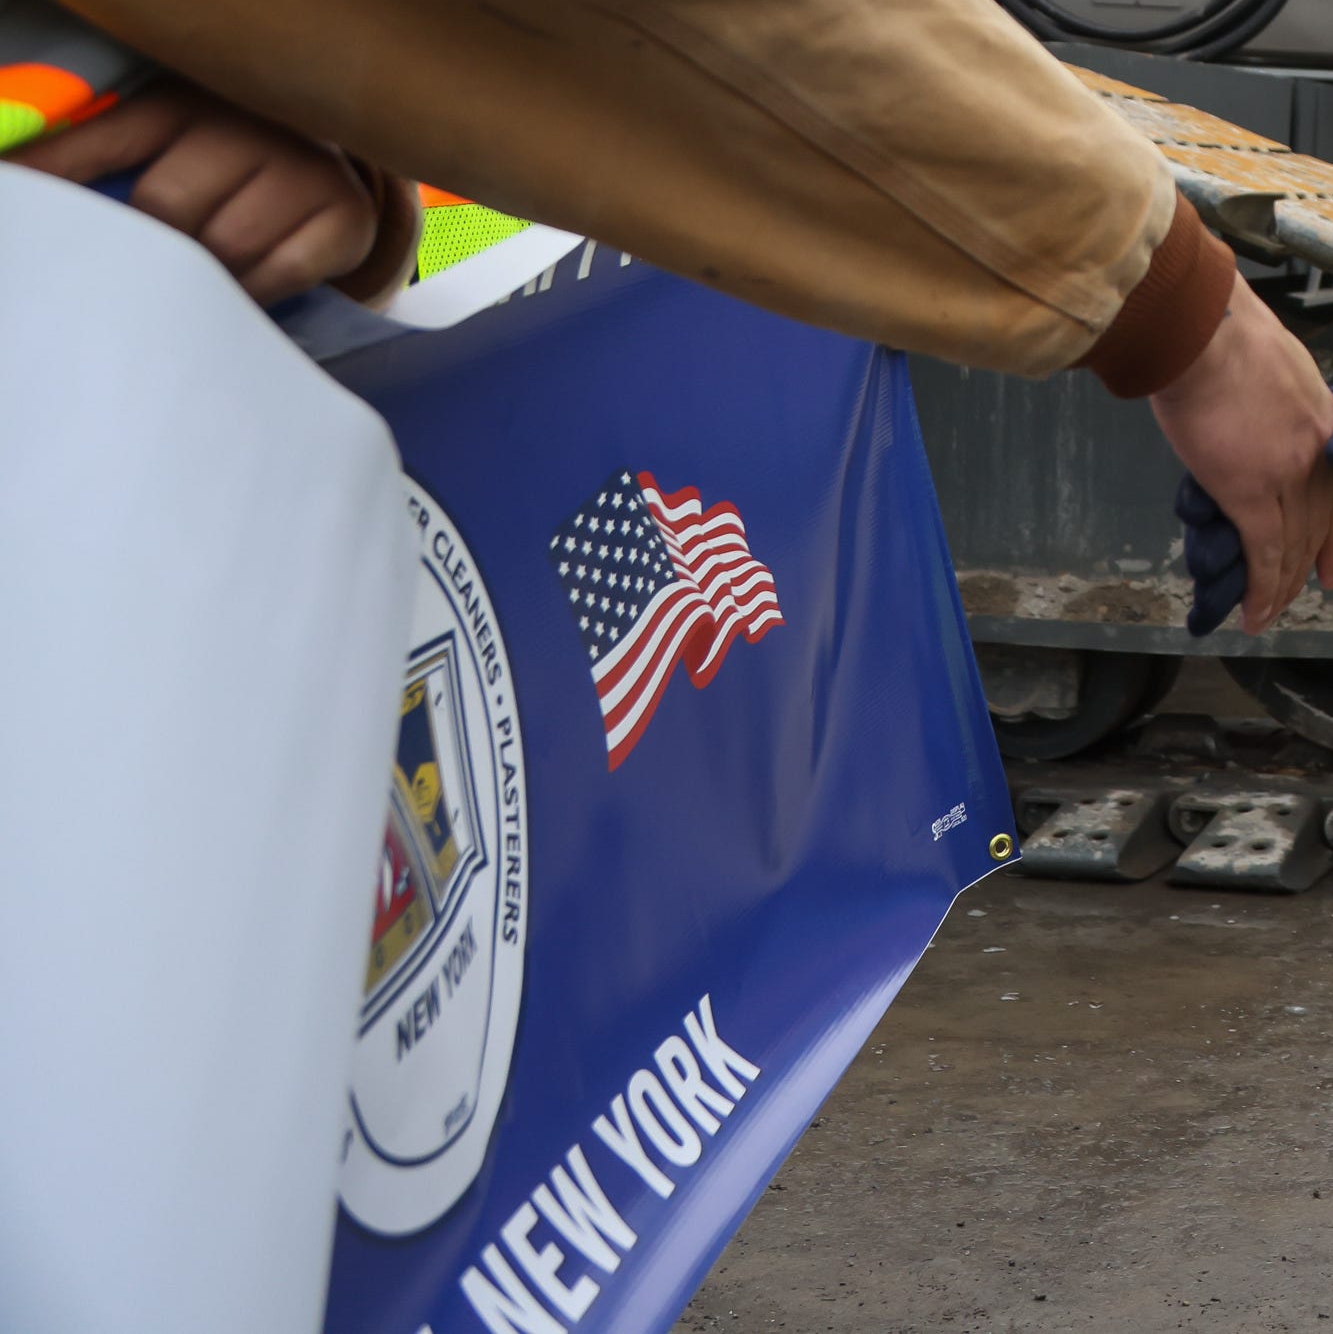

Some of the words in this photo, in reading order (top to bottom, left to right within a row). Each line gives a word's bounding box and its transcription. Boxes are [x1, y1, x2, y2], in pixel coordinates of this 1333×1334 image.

[432, 530, 502, 686] CLEANERS
[498, 716, 522, 946] PLASTERERS
[396, 974, 441, 1062] NEW
[442, 913, 478, 1001] YORK
[459, 1143, 638, 1334] NEW
[592, 993, 761, 1200] YORK
